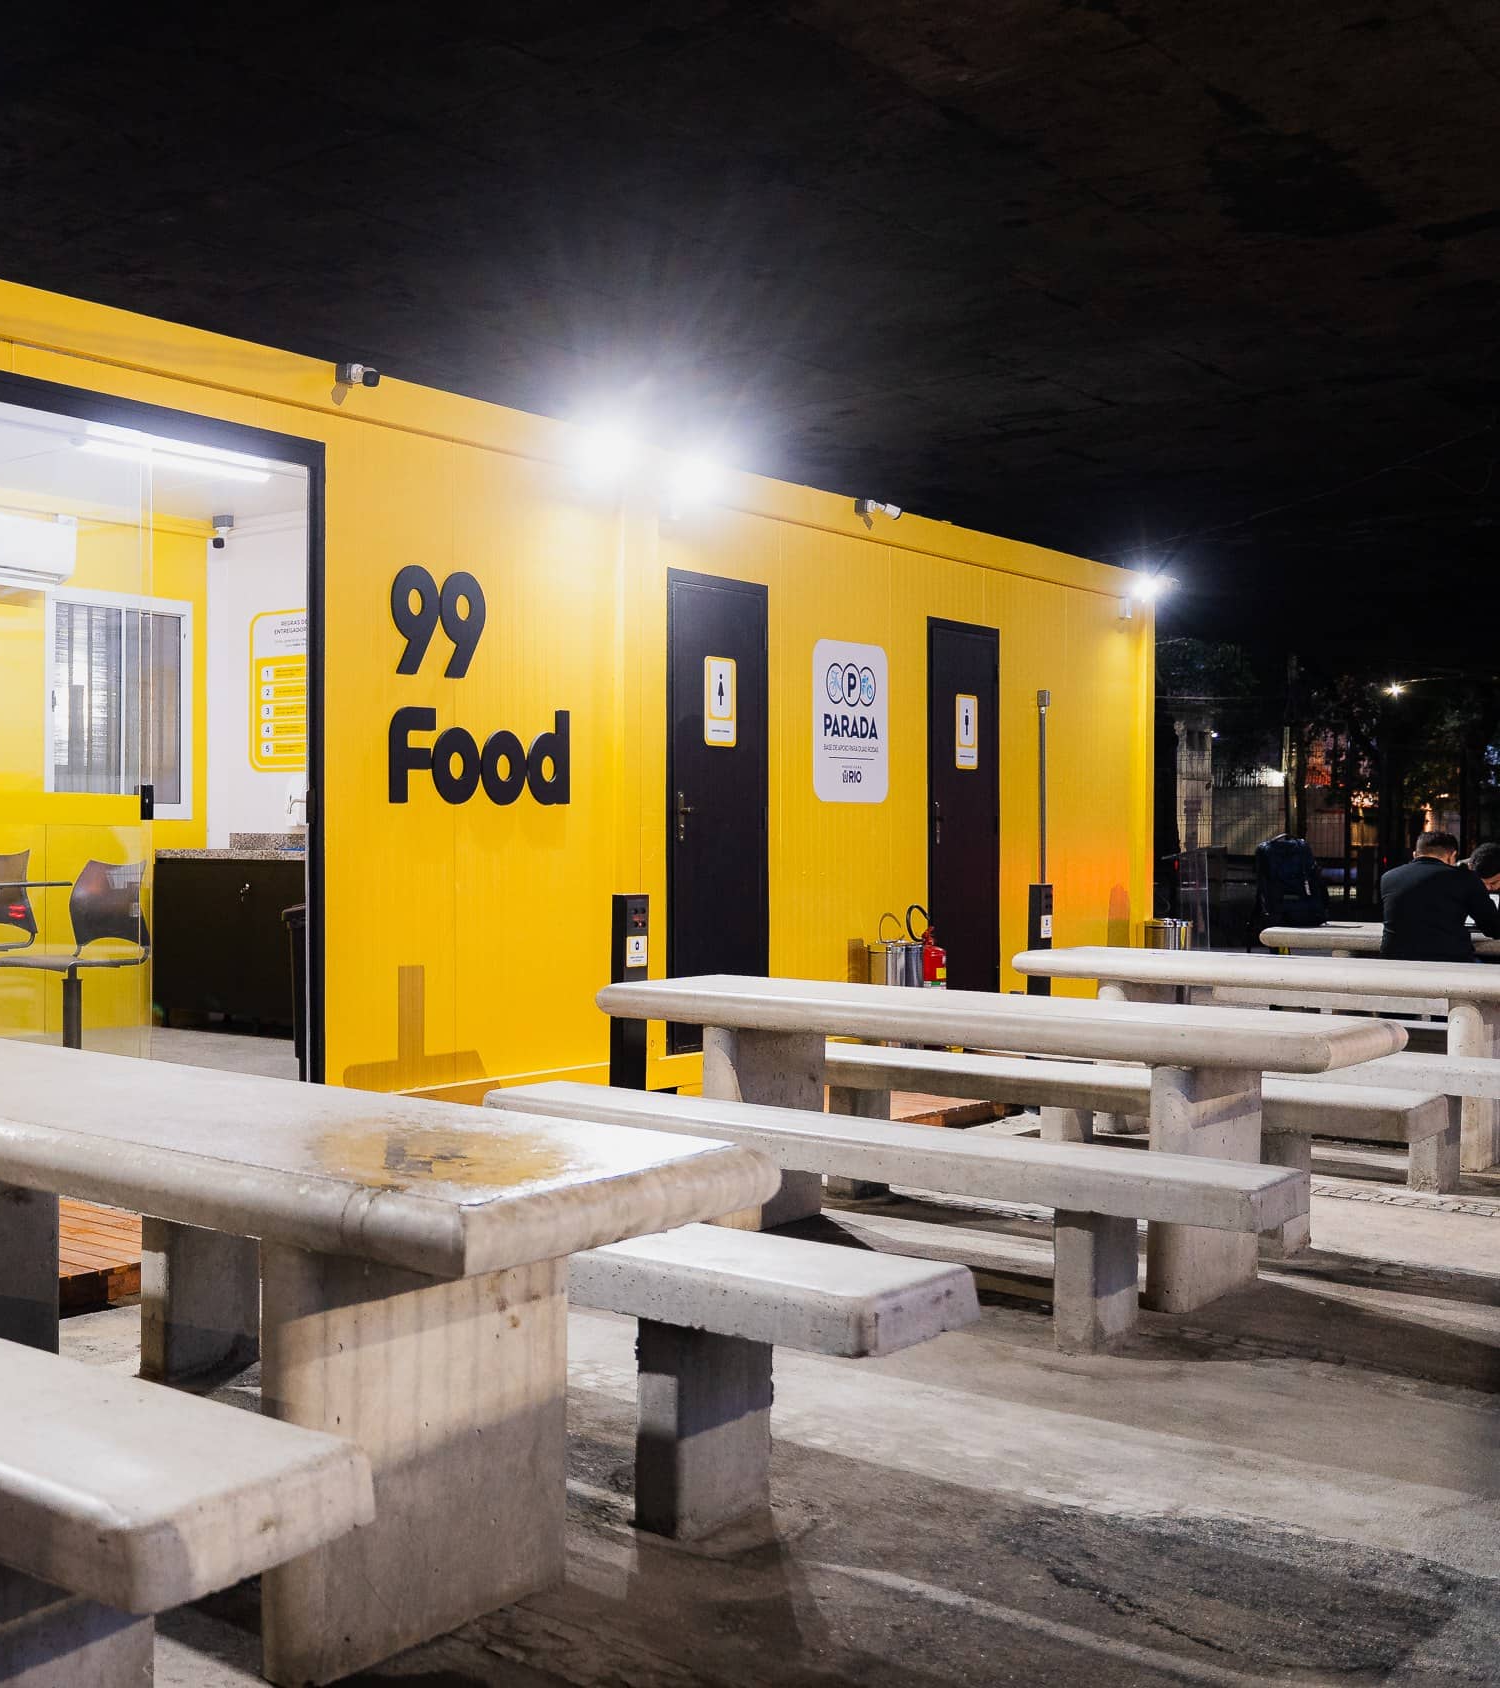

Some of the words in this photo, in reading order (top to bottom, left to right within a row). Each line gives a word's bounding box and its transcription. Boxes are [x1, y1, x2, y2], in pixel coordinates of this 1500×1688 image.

[390, 564, 486, 679] 99
[848, 672, 856, 698] P
[824, 713, 878, 740] PARADA
[388, 705, 571, 806] Food
[849, 770, 862, 783] RIO
